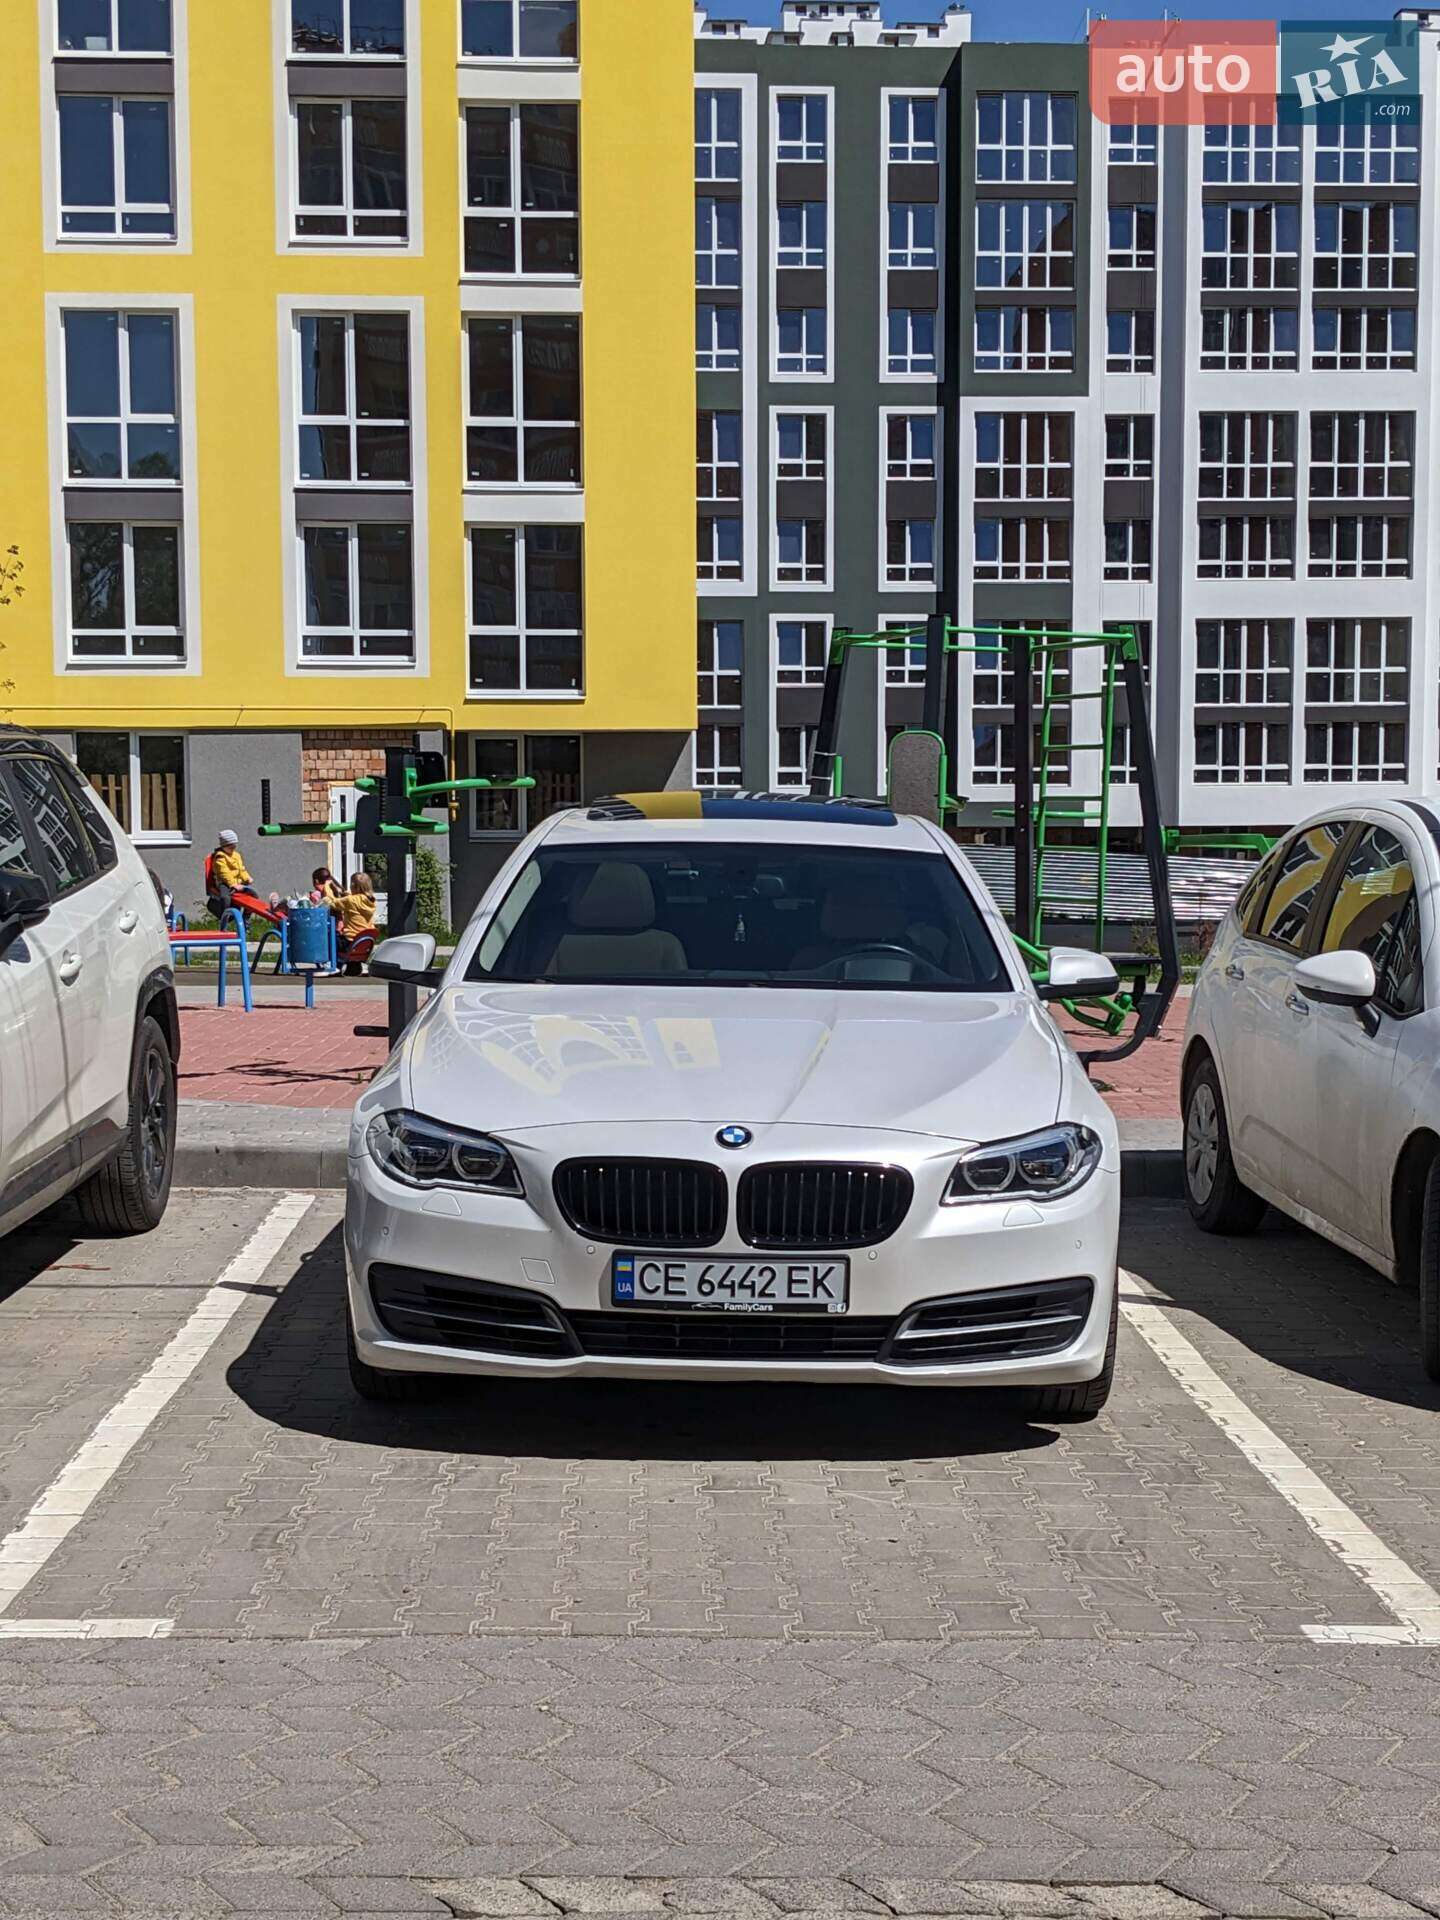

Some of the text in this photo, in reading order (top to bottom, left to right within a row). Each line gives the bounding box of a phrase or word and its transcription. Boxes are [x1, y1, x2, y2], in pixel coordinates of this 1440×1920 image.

[639, 1262, 836, 1299] CE 6442 EK
[617, 1282, 633, 1293] UA
[724, 1302, 774, 1313] FamilyCars
